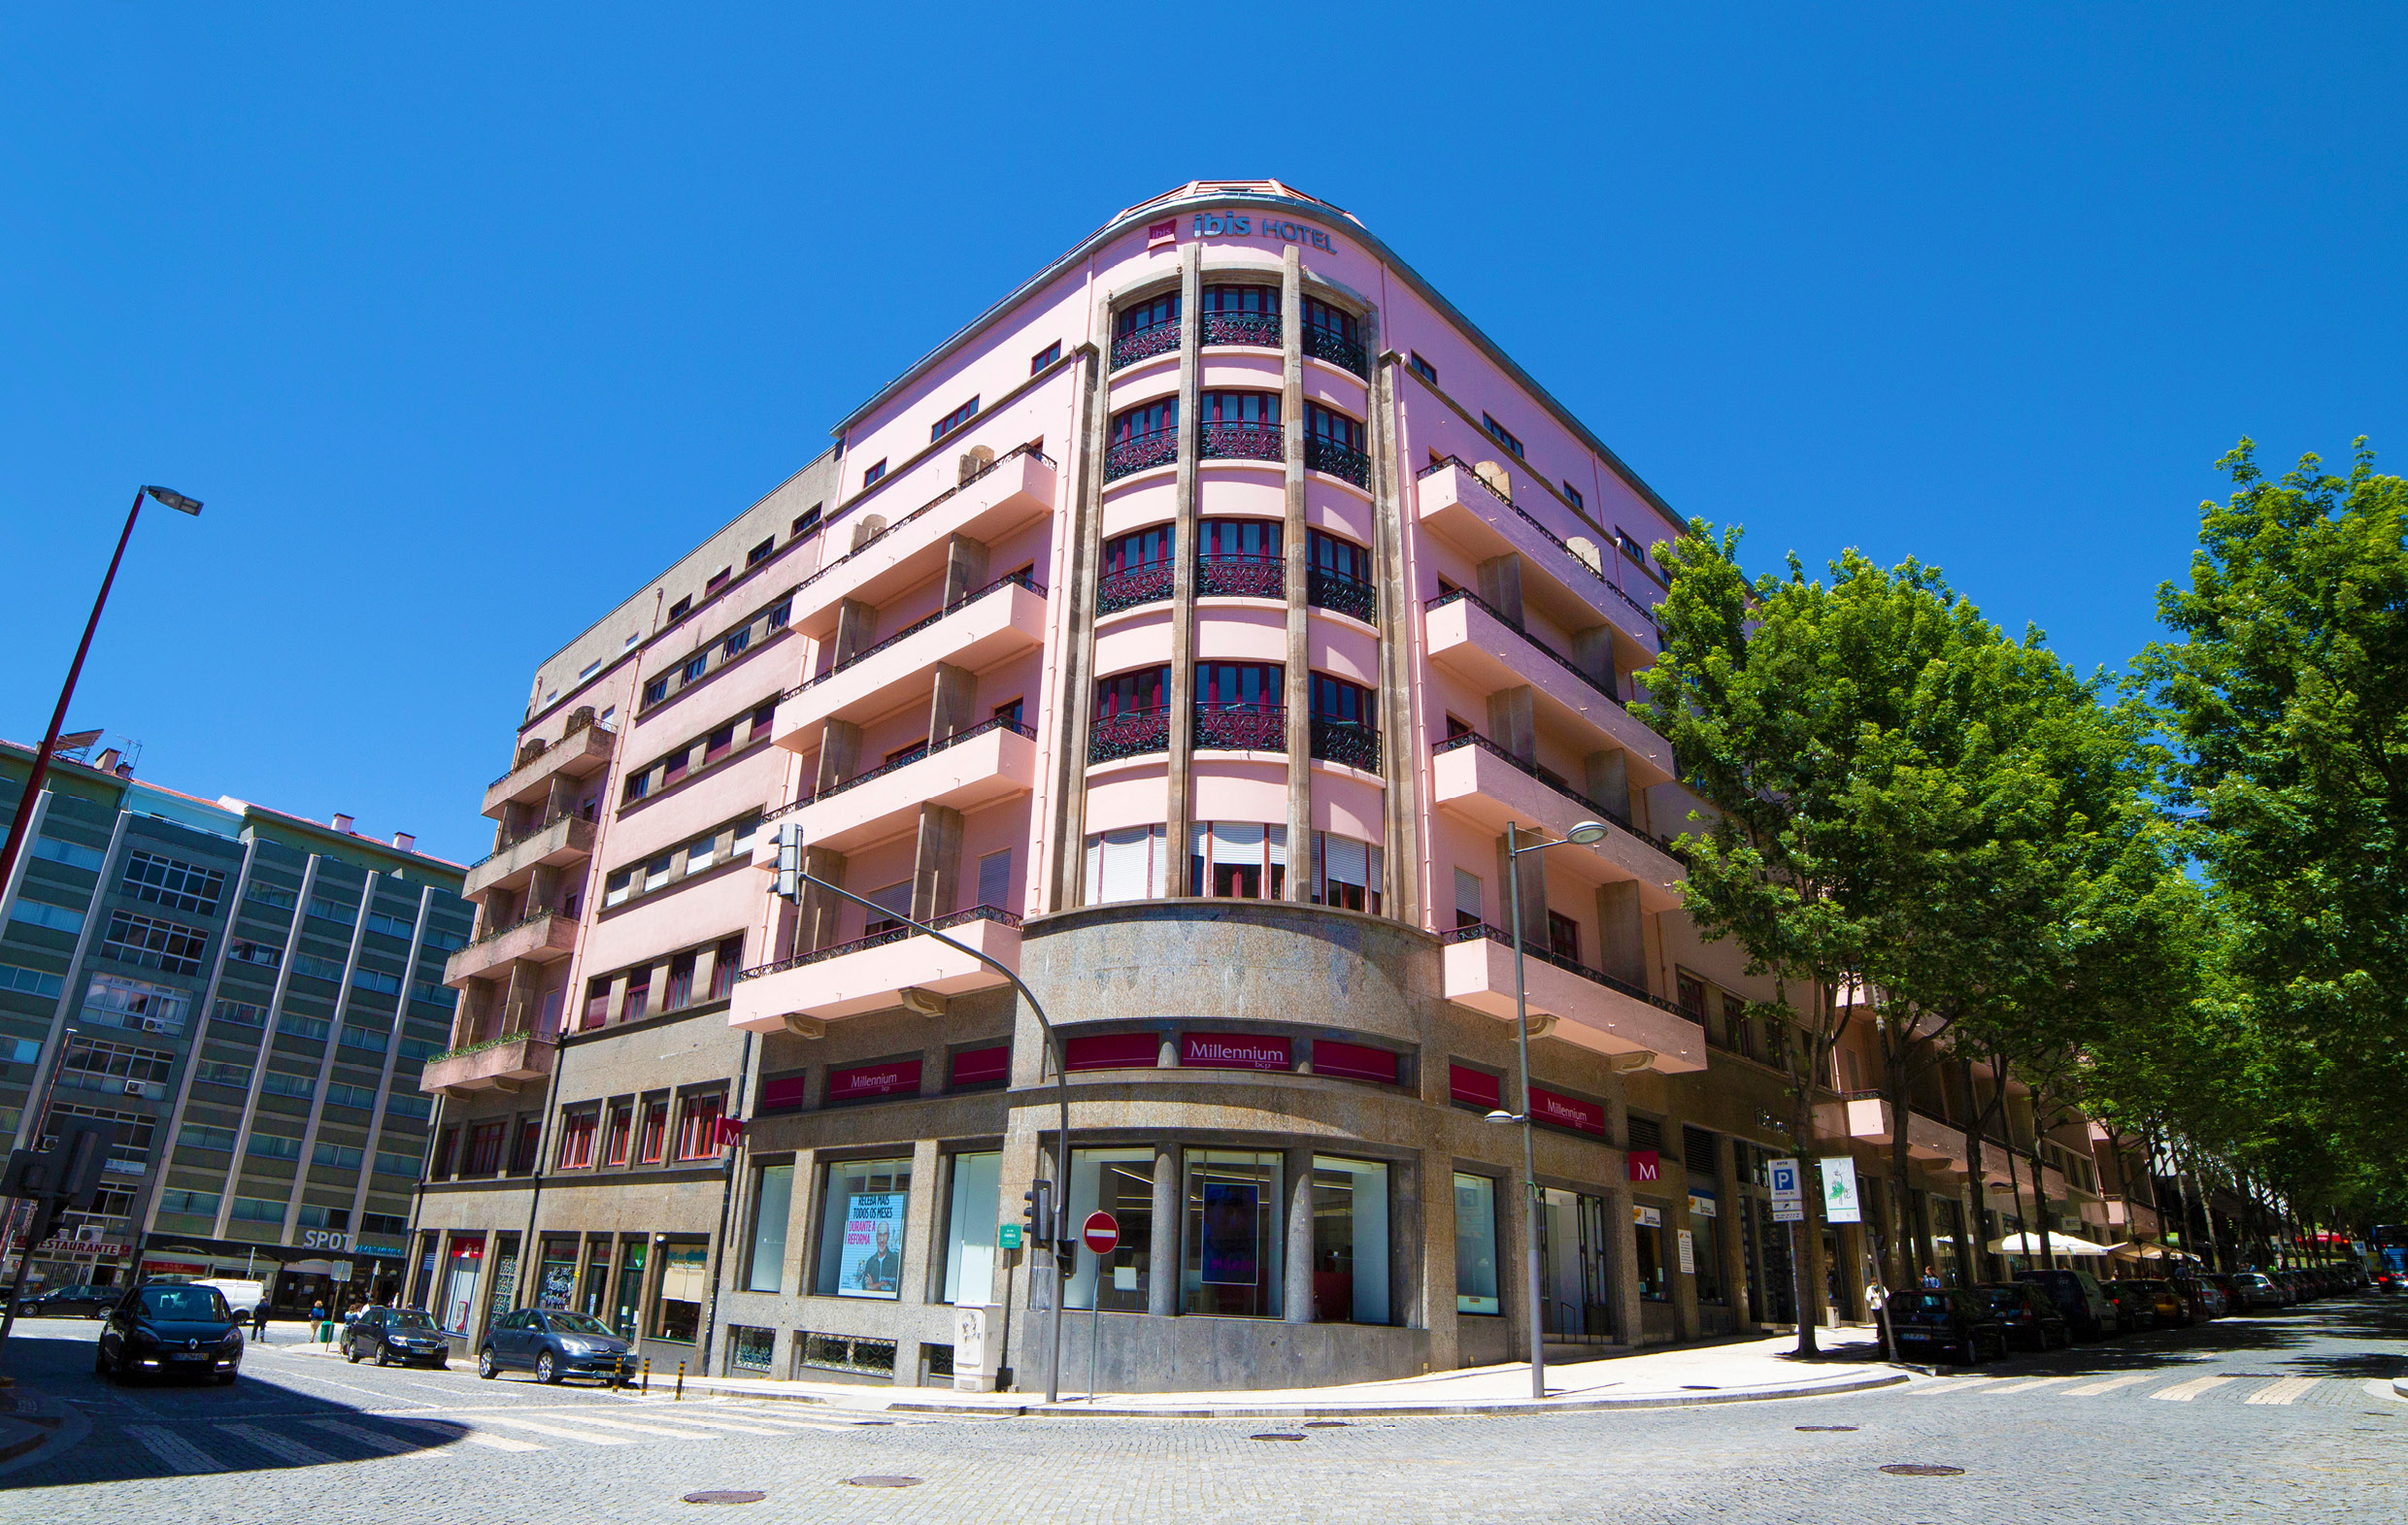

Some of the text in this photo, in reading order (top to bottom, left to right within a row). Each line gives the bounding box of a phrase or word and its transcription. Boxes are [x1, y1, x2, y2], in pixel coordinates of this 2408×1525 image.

[1152, 227, 1171, 239] ibis
[1193, 211, 1338, 254] ibis HOTEL
[1190, 1040, 1284, 1062] Millennium
[1254, 1060, 1271, 1070] bcp
[851, 1073, 897, 1088] Millennium
[1547, 1098, 1588, 1121] Millennium
[724, 1128, 740, 1146] M
[1637, 1162, 1656, 1180] M
[1778, 1172, 1789, 1188] P
[858, 1194, 890, 1206] RECEBA MAIS
[853, 1207, 893, 1219] TODOS OS MESES
[849, 1220, 876, 1233] DURANTE A
[303, 1230, 353, 1251] SPOT
[848, 1233, 871, 1244] REFORMA
[39, 1240, 117, 1254] ESTAURANTE
